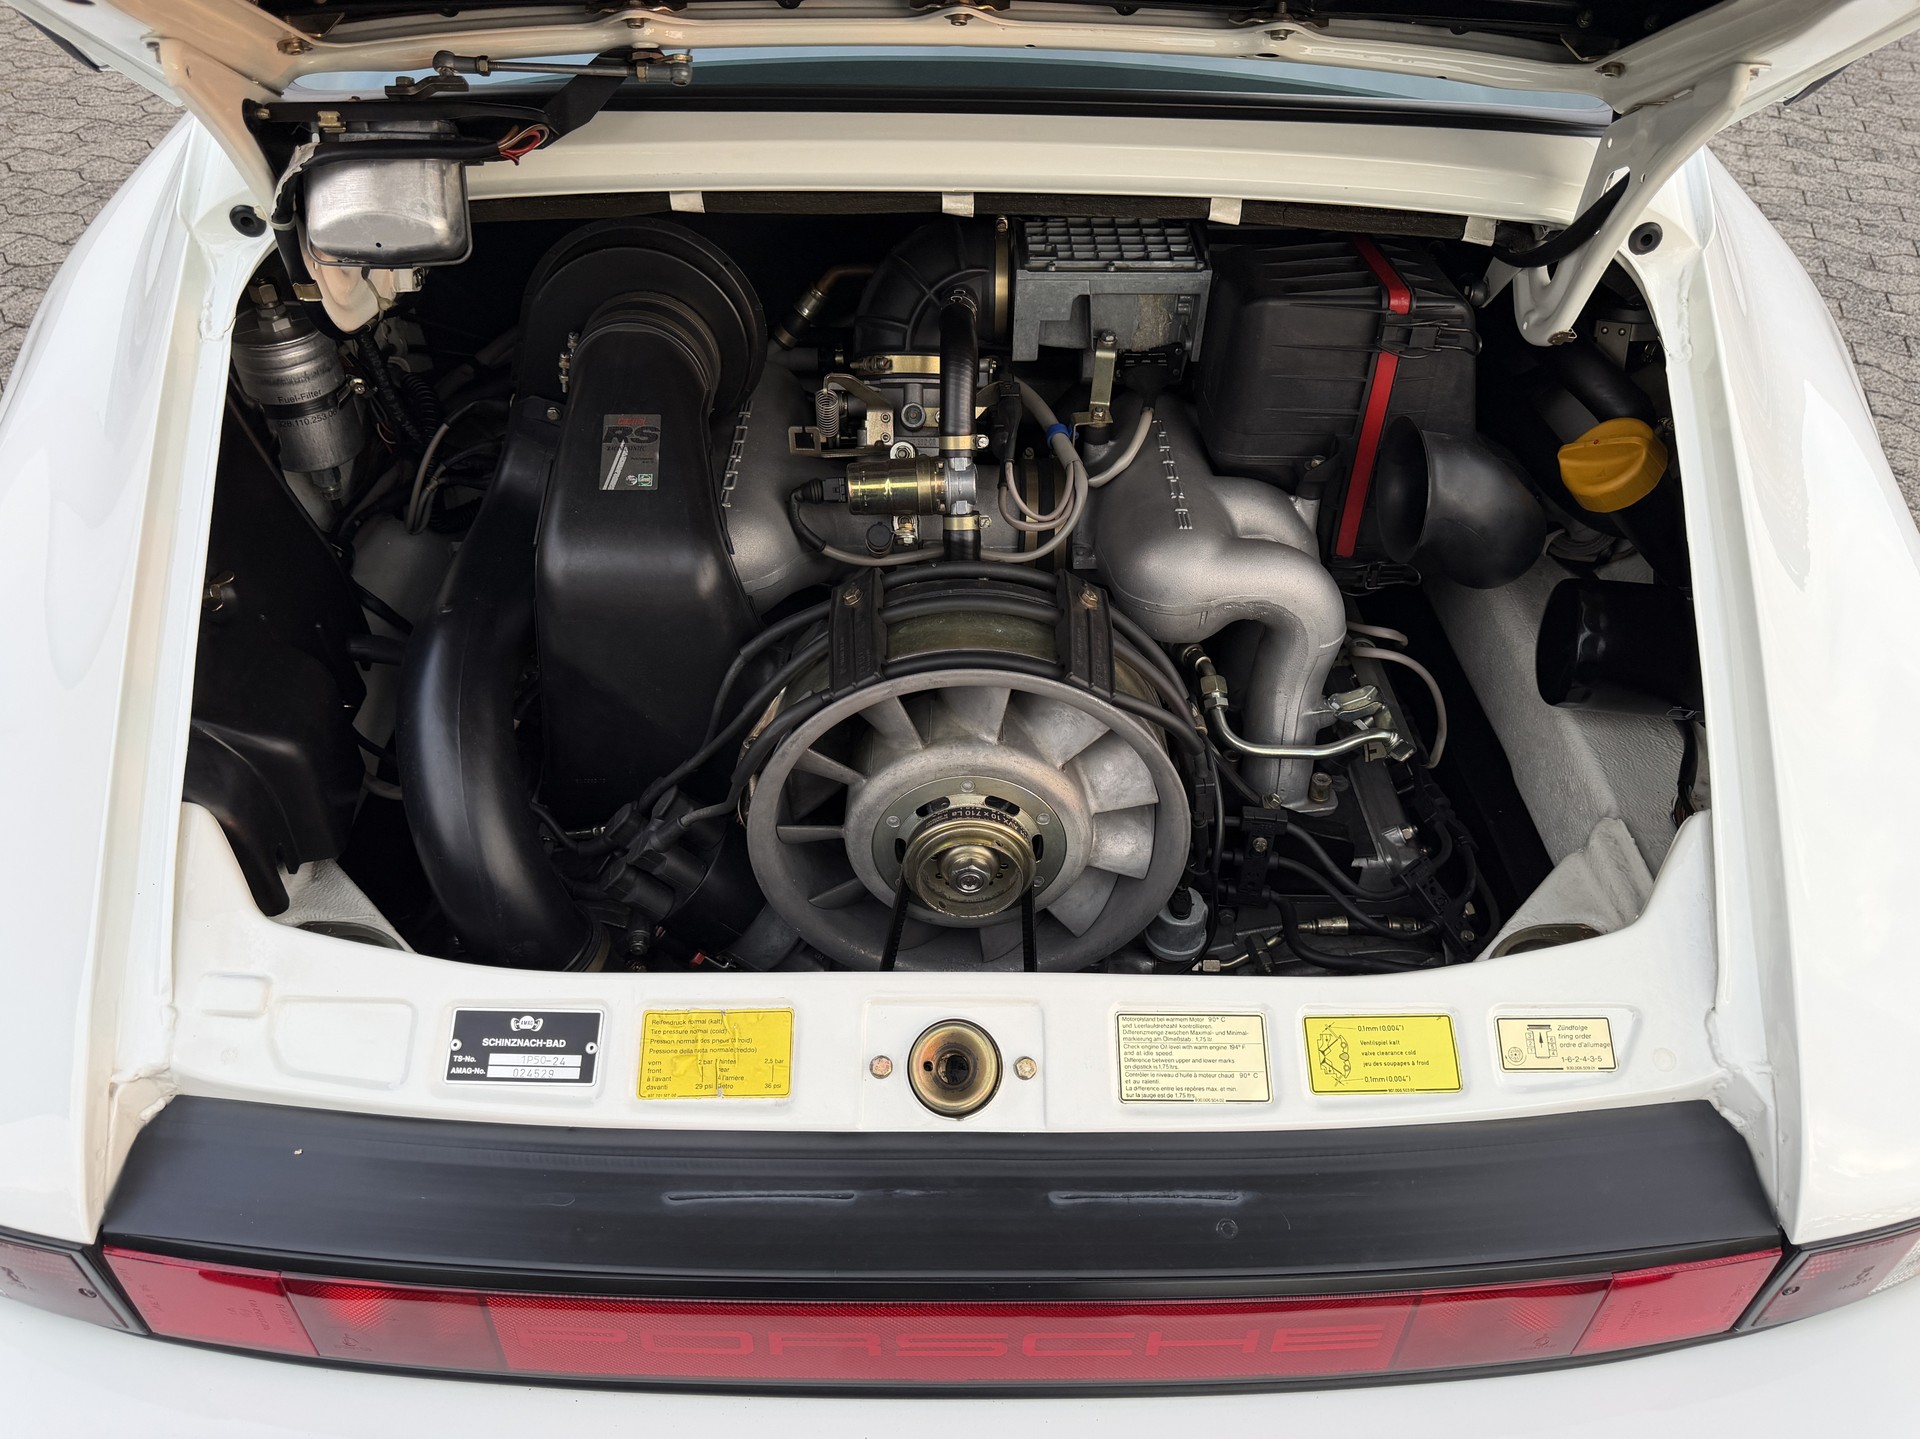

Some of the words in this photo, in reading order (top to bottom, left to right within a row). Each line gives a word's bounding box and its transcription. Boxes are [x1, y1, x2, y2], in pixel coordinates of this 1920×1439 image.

[278, 390, 322, 403] Fuel-Filter
[602, 426, 660, 443] RS
[991, 813, 1001, 821] 10
[482, 1038, 566, 1048] SCHINZNACH-BAD
[513, 1068, 554, 1078] 024529
[515, 1324, 1385, 1357] PORSCHE
